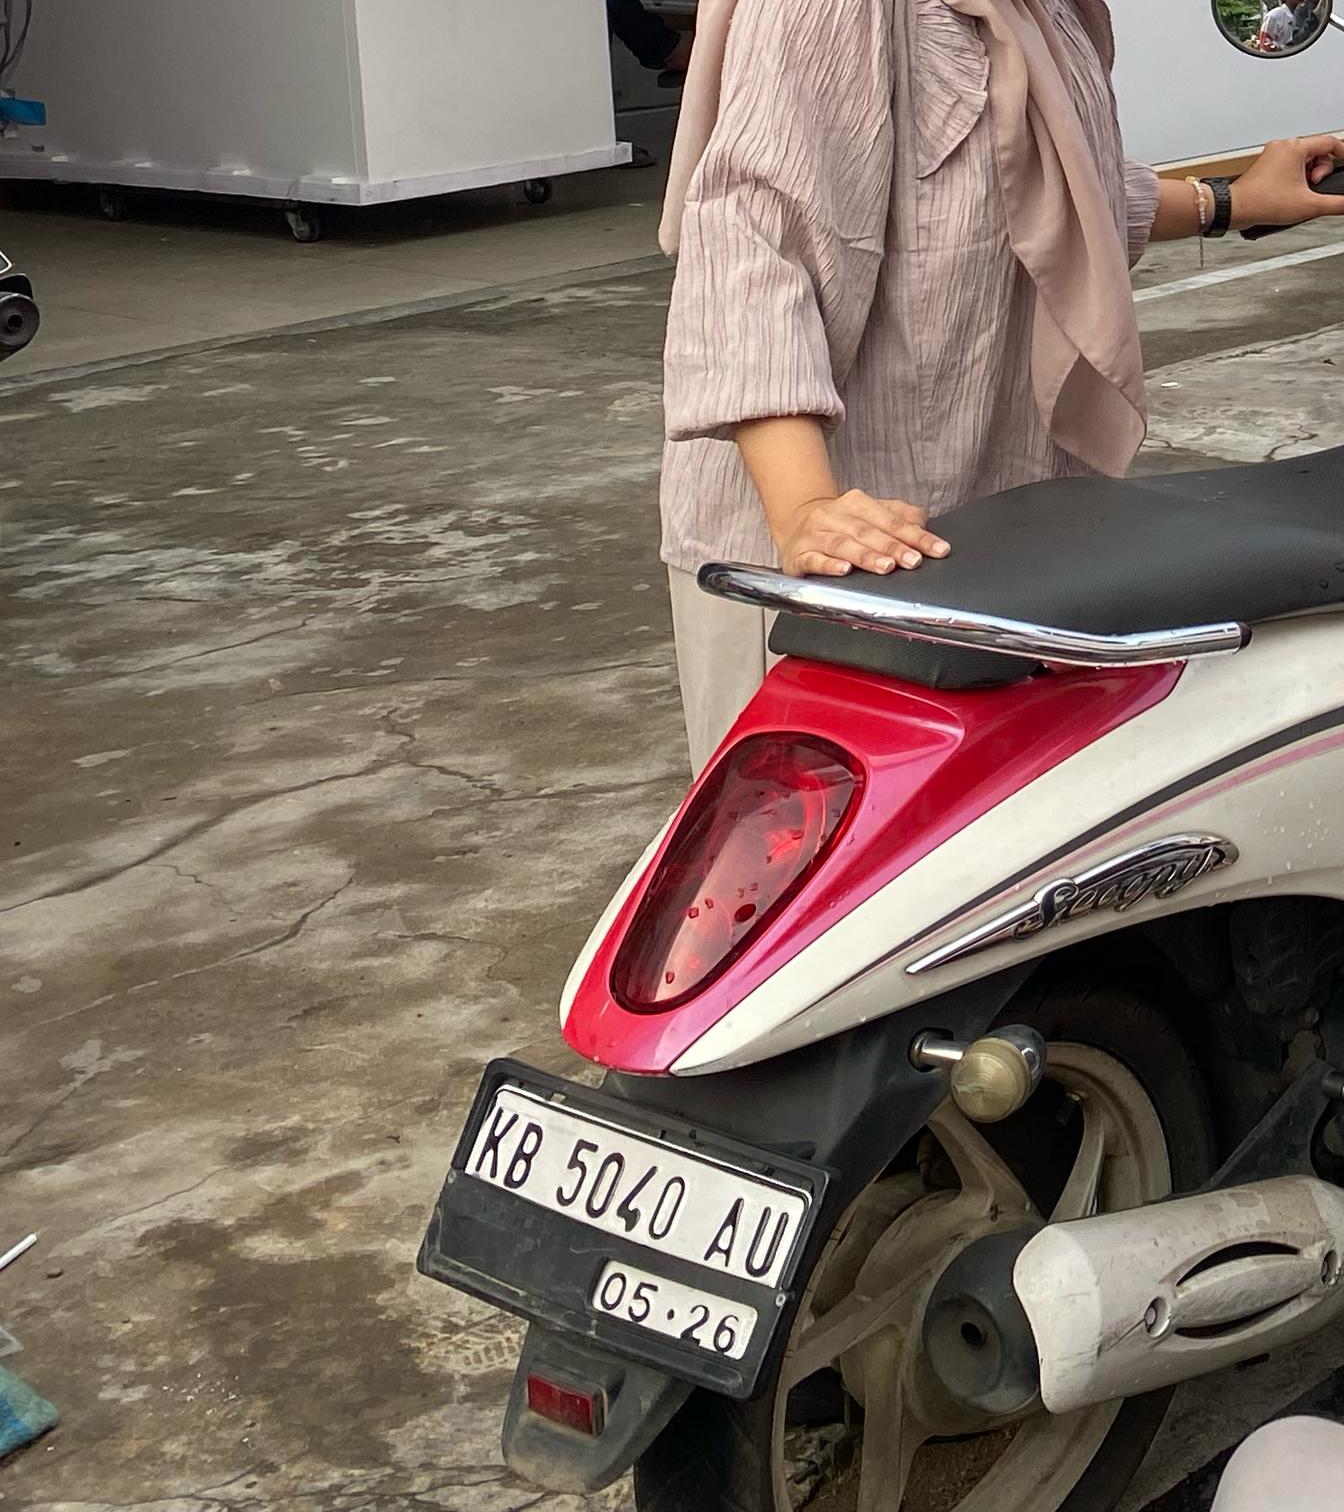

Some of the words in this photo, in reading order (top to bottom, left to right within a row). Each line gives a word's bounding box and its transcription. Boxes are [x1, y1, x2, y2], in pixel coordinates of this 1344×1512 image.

[475, 1105, 544, 1190] KB
[555, 1138, 687, 1241] 5040
[703, 1196, 790, 1279] AU
